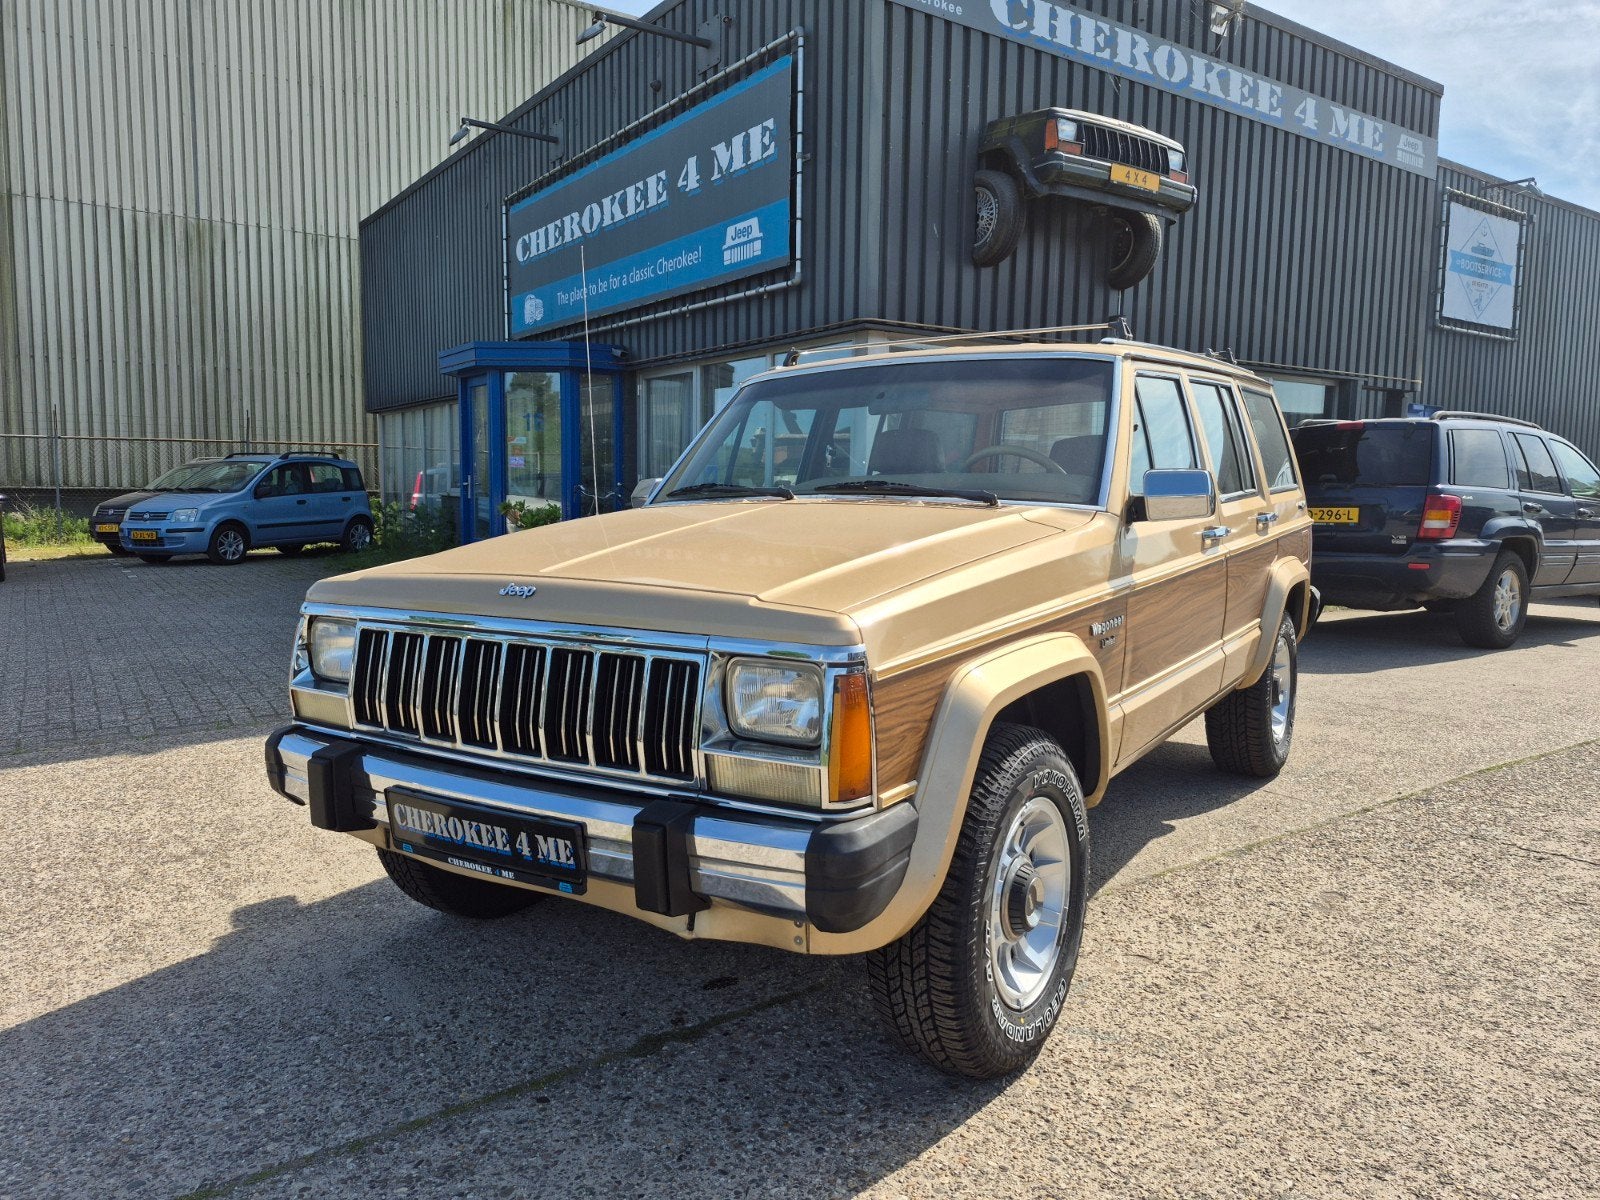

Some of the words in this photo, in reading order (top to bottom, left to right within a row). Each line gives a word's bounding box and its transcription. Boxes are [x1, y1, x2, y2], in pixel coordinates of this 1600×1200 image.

[990, 0, 1283, 119] CHEROKEE
[1294, 97, 1319, 131] 4
[1329, 106, 1384, 153] ME
[1403, 137, 1420, 151] Jeep
[515, 170, 668, 264] CHEROKEE
[677, 155, 702, 193] 4
[710, 117, 777, 182] ME
[731, 224, 753, 241] Jeep
[557, 292, 569, 306] The
[570, 286, 588, 306] place
[589, 284, 597, 296] to
[598, 278, 608, 293] be
[609, 274, 621, 290] for
[622, 274, 628, 286] a
[629, 262, 655, 284] classic
[656, 245, 702, 275] Cherokee!
[499, 582, 537, 599] Jeep
[1091, 615, 1124, 637] Wagoneer
[1033, 768, 1086, 842] YOKOHAMA
[393, 803, 512, 852] CHEROKEE
[515, 831, 531, 857] 4
[535, 834, 576, 867] ME
[448, 857, 493, 875] CHEROKEE
[496, 868, 500, 876] 4
[501, 871, 515, 880] ME
